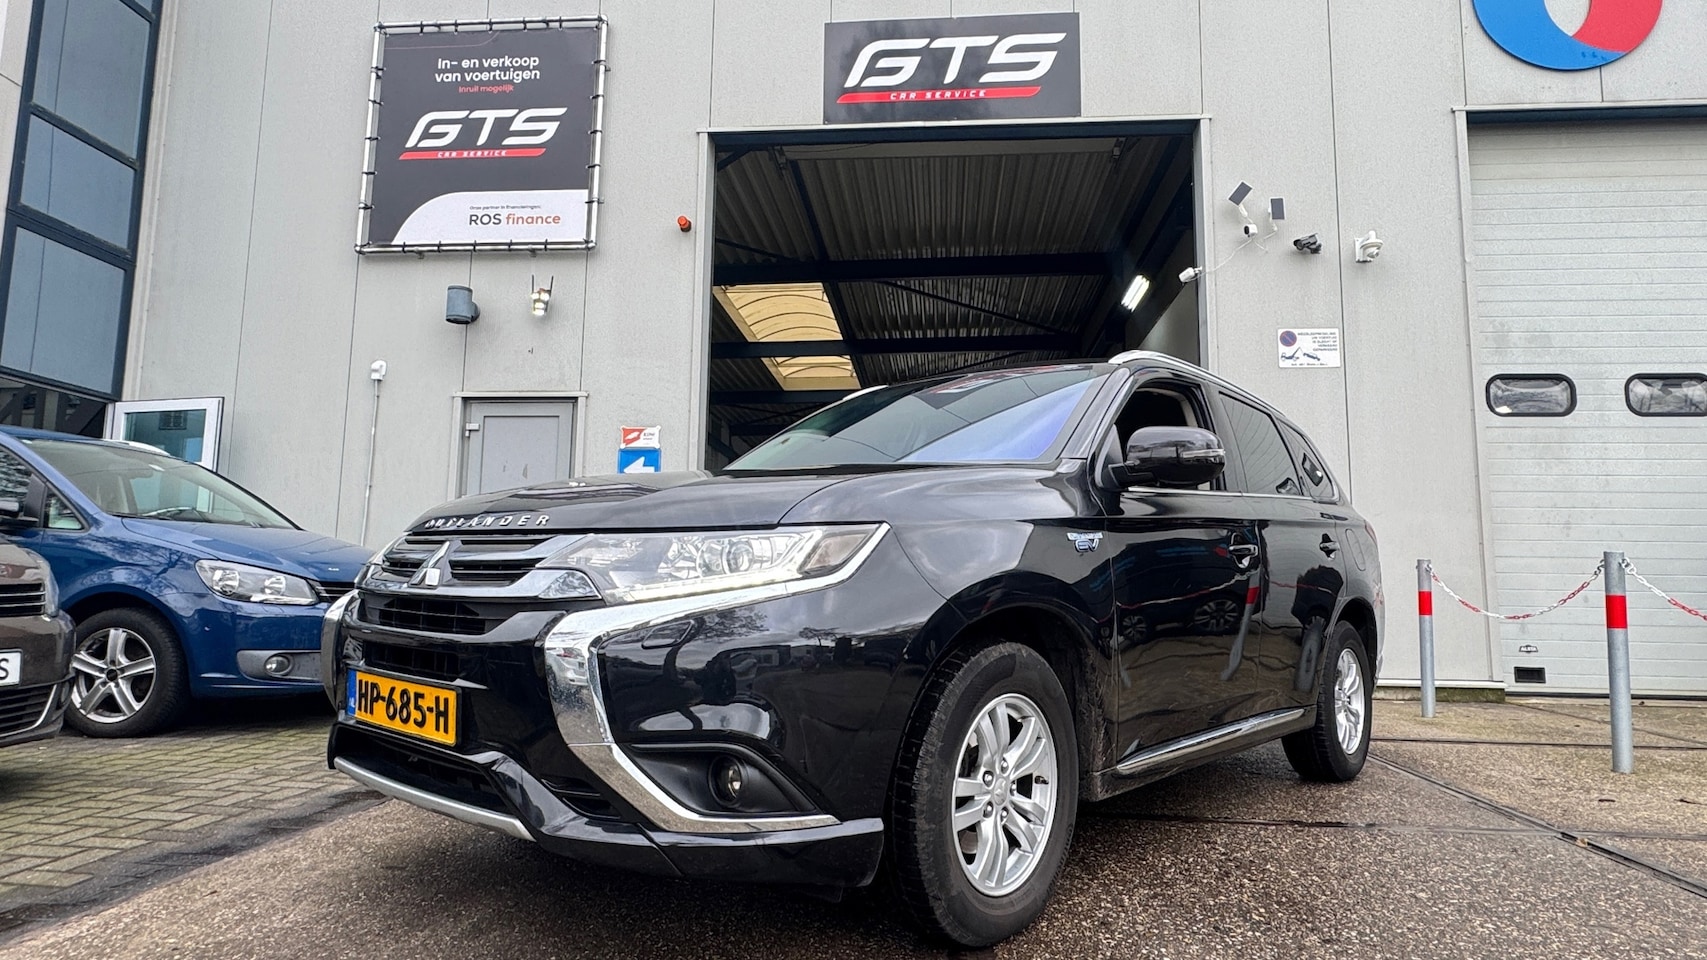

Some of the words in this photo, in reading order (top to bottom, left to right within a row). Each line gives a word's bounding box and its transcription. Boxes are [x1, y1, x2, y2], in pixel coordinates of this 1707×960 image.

[437, 58, 458, 69] In-
[461, 58, 479, 68] en
[482, 55, 540, 69] verkoop
[844, 32, 1067, 88] GTS
[435, 72, 461, 82] van
[464, 68, 540, 83] voertuigen
[458, 85, 479, 93] Inruil
[480, 84, 514, 94] mogelijk
[890, 92, 916, 100] CAR
[925, 89, 986, 99] SERVICE
[405, 107, 568, 148] GTS
[437, 151, 457, 159] CAR
[462, 150, 507, 158] SERVICE
[469, 213, 502, 225] ROS
[505, 213, 561, 225] finance
[1075, 538, 1099, 552] EV
[358, 679, 448, 734] HP-685-H
